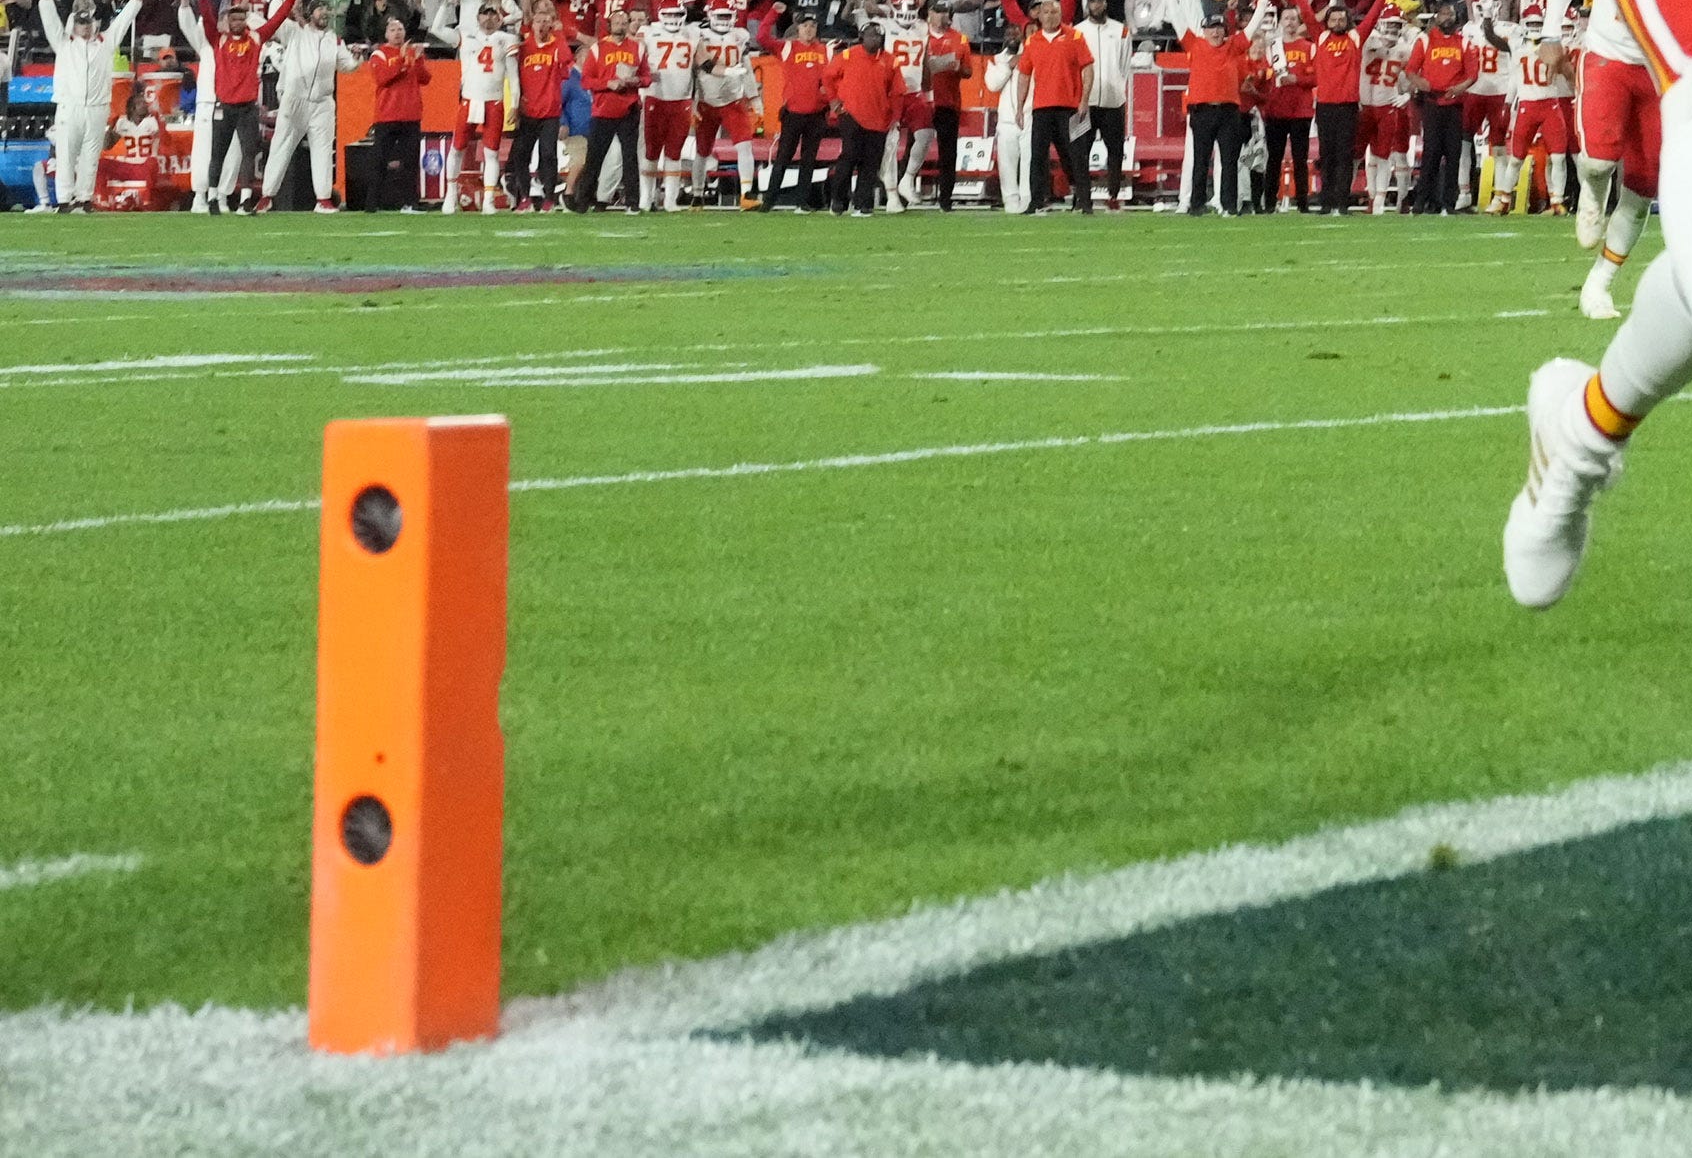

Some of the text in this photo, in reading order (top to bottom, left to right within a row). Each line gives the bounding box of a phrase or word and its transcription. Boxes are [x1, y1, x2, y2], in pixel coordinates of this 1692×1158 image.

[477, 46, 494, 73] 4
[656, 41, 692, 70] 73
[893, 39, 926, 67] 67
[1430, 47, 1462, 62] CHIEFS
[1365, 57, 1401, 88] 45
[1518, 55, 1549, 87] 10
[124, 135, 152, 158] 26
